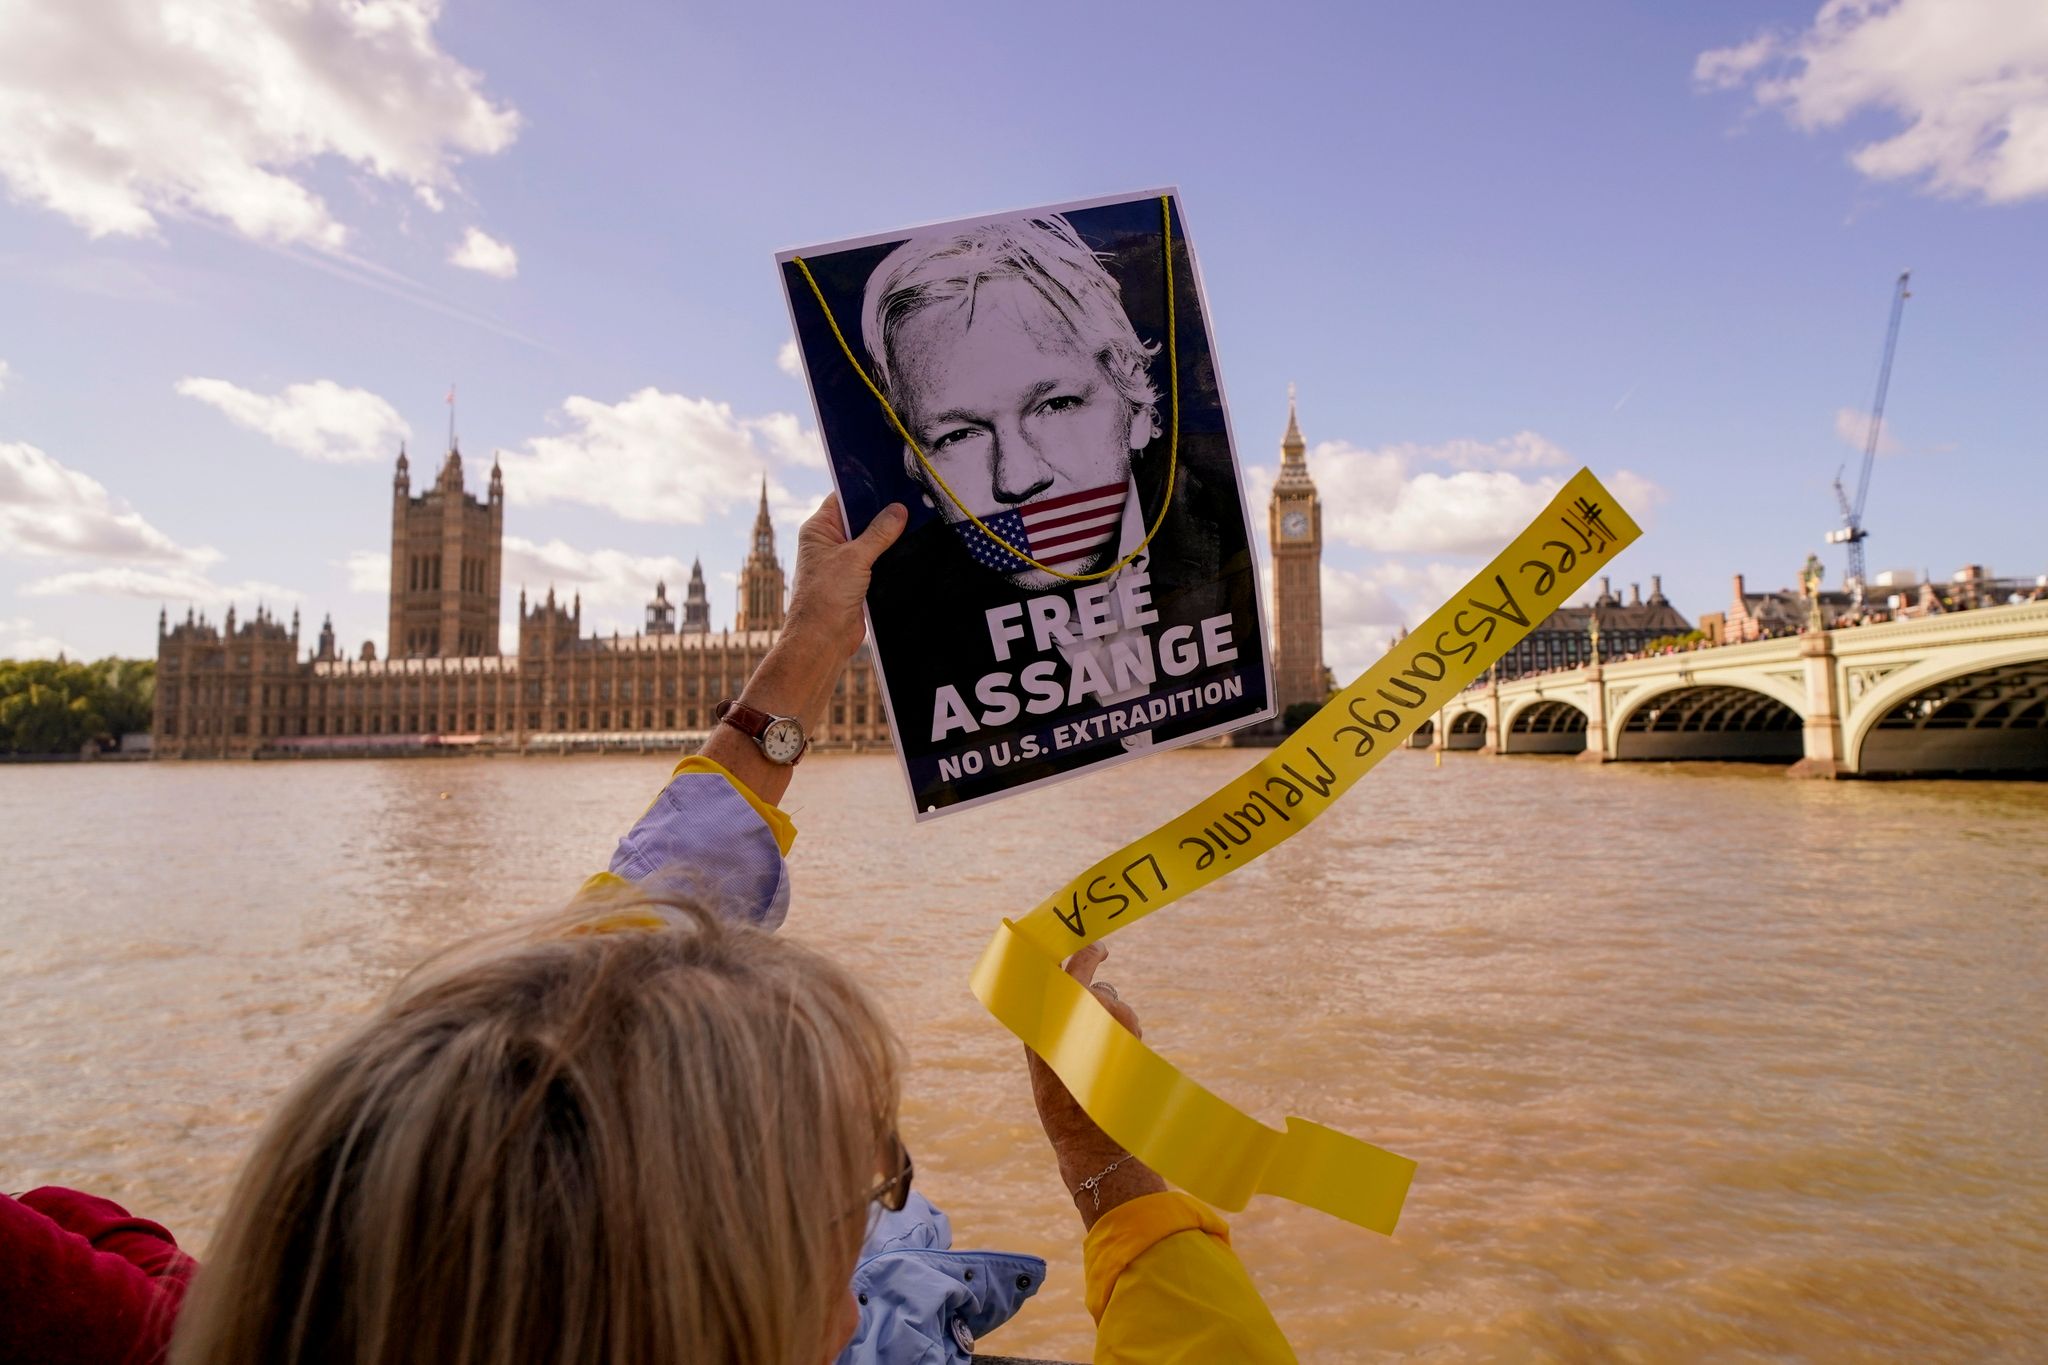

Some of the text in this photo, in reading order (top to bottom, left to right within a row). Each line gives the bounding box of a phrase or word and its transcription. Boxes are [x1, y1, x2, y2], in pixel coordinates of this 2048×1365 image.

[1519, 496, 1618, 597] #Free
[984, 572, 1160, 662] FREE
[1333, 574, 1531, 758] Assange
[930, 612, 1239, 743] ASSANGE
[937, 674, 1244, 783] NO U.S. EXTRADITION
[1178, 746, 1337, 871] Melanie
